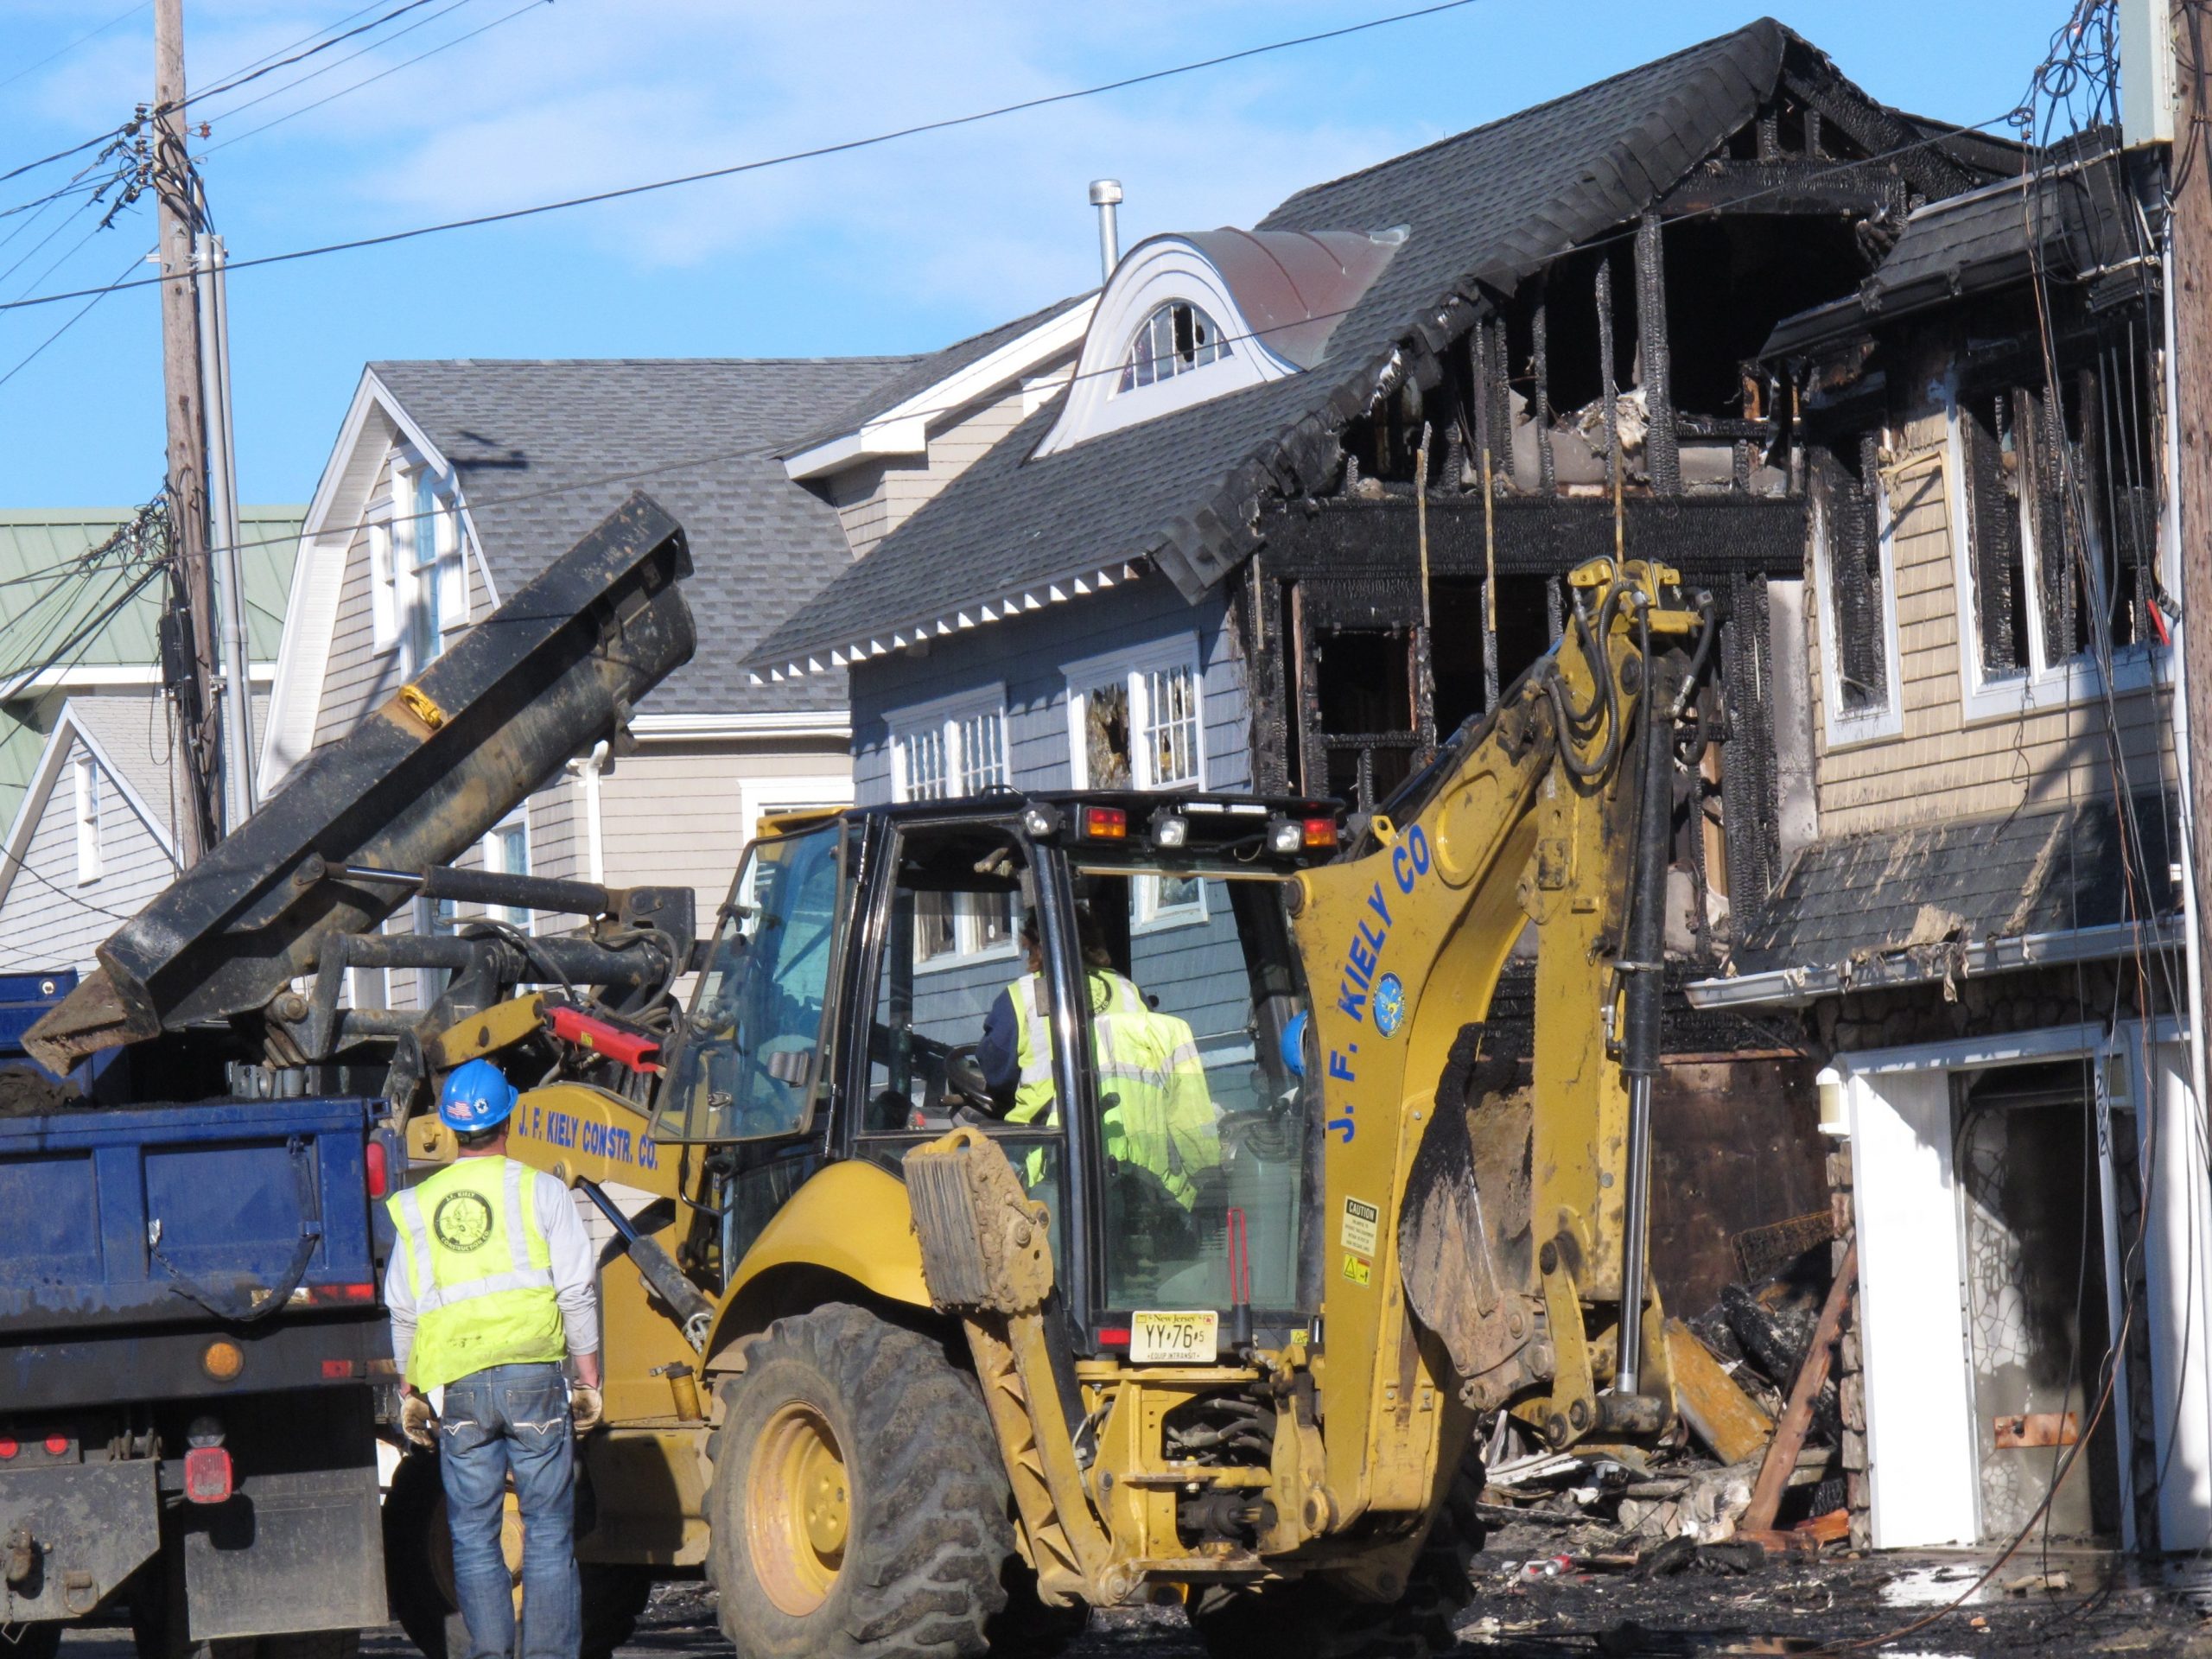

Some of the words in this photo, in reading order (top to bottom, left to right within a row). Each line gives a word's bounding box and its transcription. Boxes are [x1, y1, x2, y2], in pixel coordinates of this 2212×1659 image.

[1392, 823, 1430, 895] CO
[1337, 880, 1393, 1023] KIELY
[1329, 1042, 1357, 1082] F.
[518, 1104, 528, 1137] J.
[532, 1107, 543, 1141] F.
[547, 1110, 579, 1148] KIELY
[582, 1120, 633, 1165] CONSTR.
[638, 1133, 658, 1171] CO.
[1328, 1105, 1355, 1144] J.
[1349, 1201, 1375, 1221] CAUTION
[1154, 1313, 1171, 1322] New
[1173, 1313, 1196, 1323] Jersey
